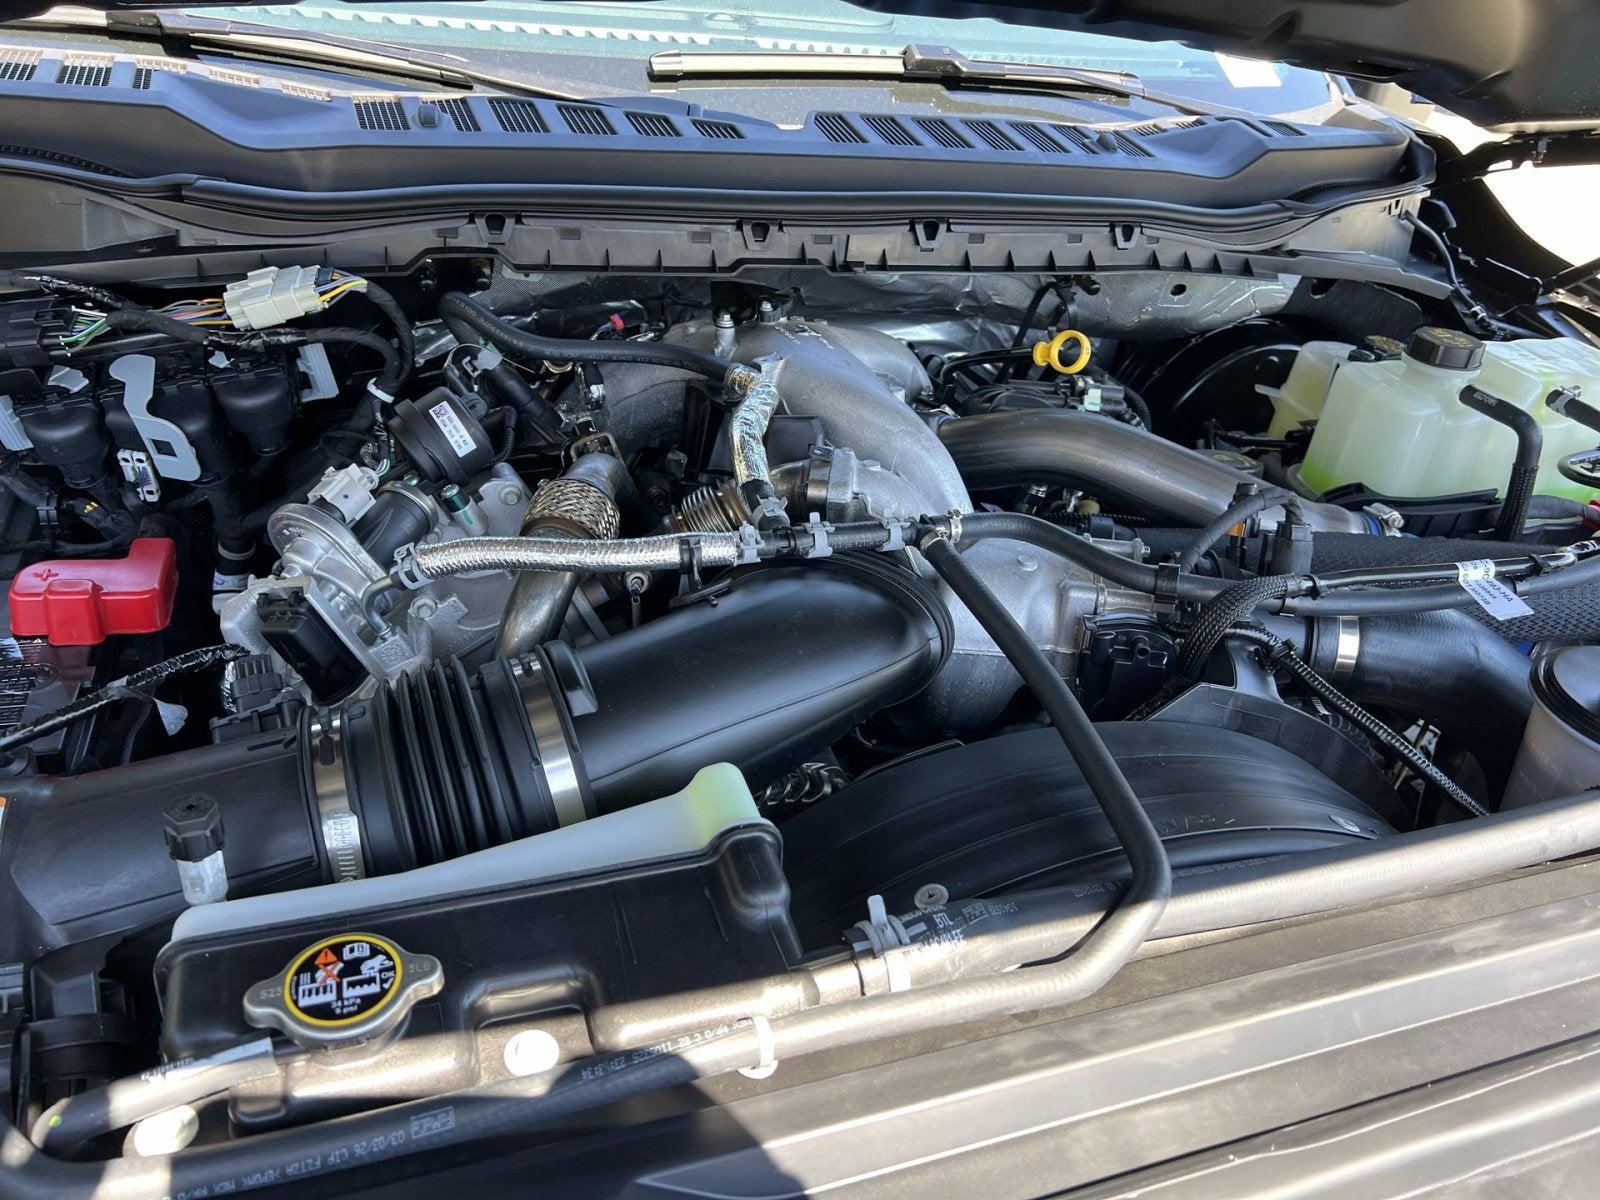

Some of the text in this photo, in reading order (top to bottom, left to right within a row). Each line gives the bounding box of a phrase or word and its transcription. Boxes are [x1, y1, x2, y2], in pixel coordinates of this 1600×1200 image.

[932, 912, 954, 928] BTL
[381, 971, 395, 979] OK
[259, 987, 283, 999] S25
[343, 998, 361, 1008] kPa
[343, 1006, 358, 1015] psi
